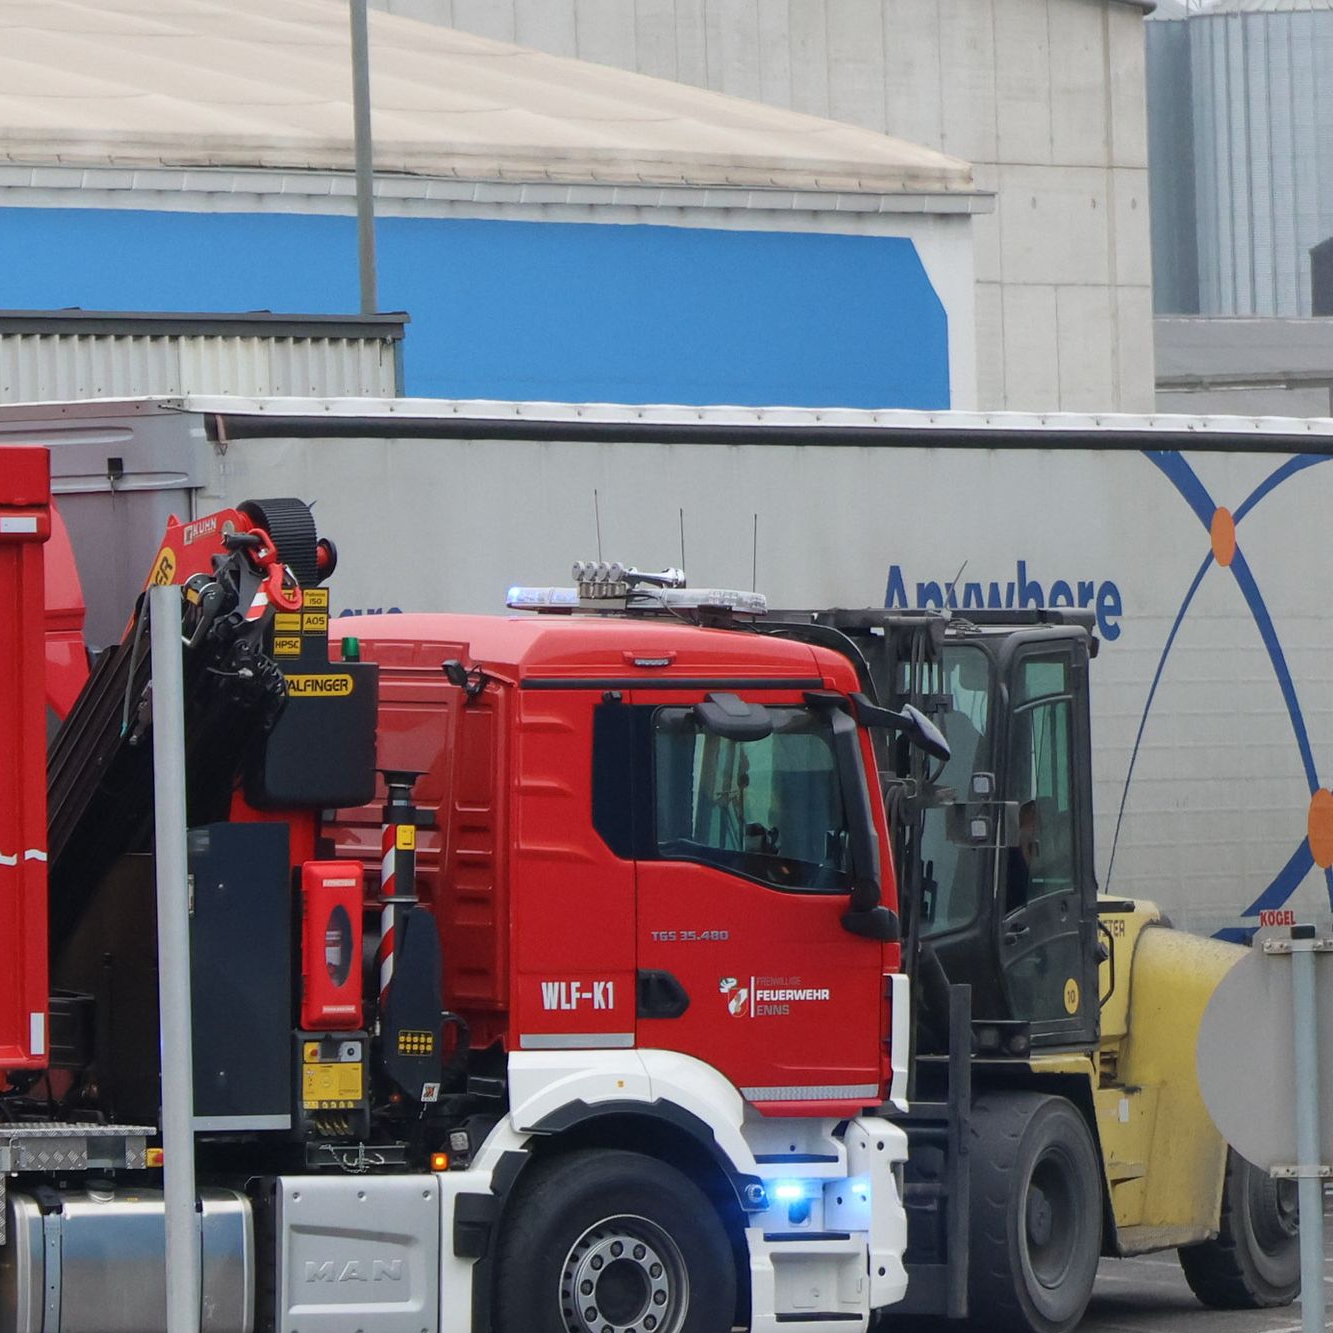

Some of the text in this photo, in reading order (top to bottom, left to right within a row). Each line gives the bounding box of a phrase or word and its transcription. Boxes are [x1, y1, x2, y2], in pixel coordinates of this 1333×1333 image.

[305, 617, 325, 625] AOS
[275, 640, 299, 649] HPSC
[286, 679, 348, 692] ALFINGER
[1260, 910, 1296, 927] KÖGEL
[652, 931, 729, 941] TGS 35.480
[541, 981, 614, 1010] WLF-K1
[756, 989, 830, 1001] FEUERWEHR
[756, 1005, 790, 1015] ENNS
[304, 1259, 402, 1283] MAN
